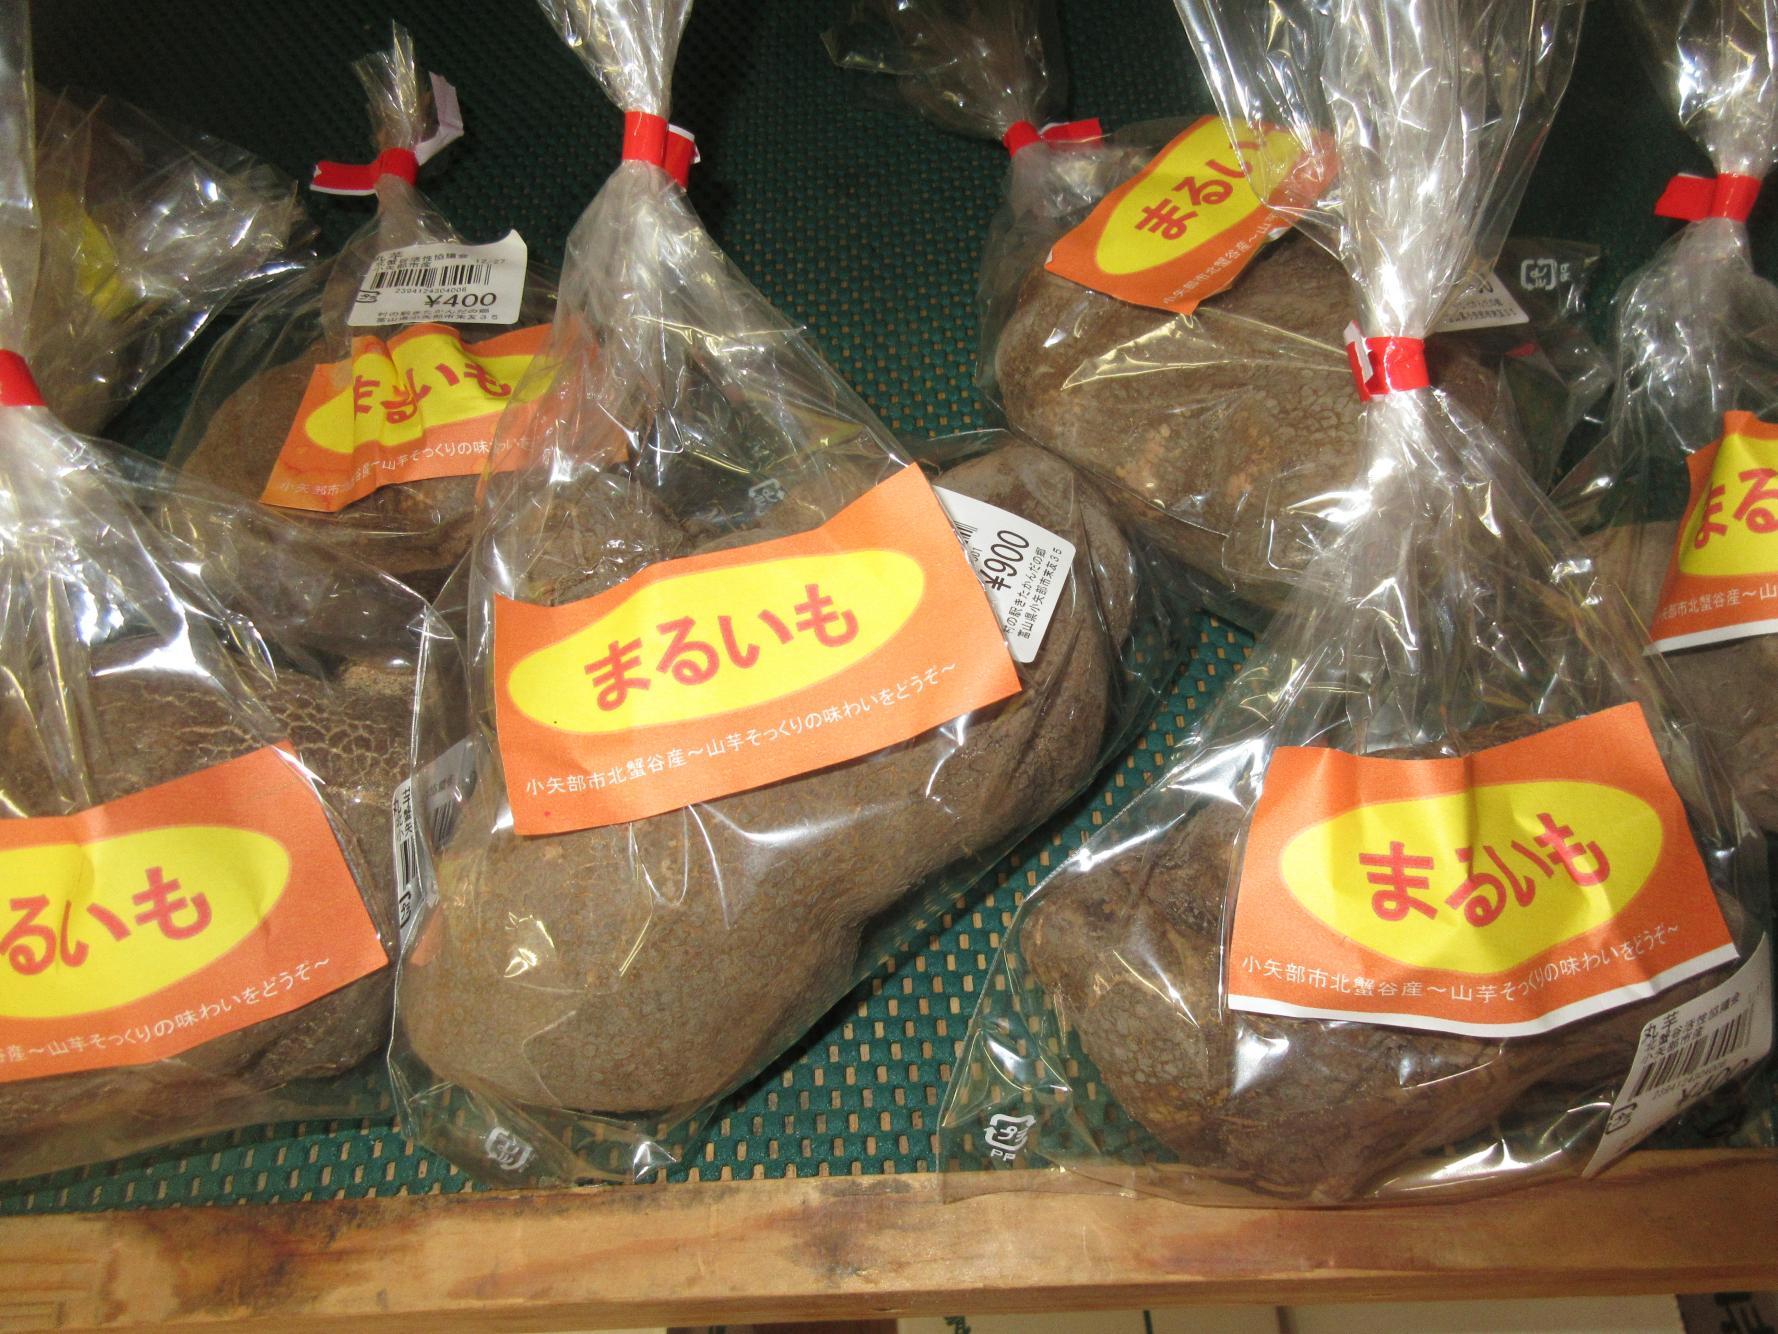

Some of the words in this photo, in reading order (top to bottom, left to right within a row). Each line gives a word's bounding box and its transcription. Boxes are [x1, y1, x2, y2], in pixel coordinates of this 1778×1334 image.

[424, 292, 498, 308] ¥400
[980, 530, 1029, 591] ¥900
[583, 583, 859, 712] まるいも
[1358, 812, 1611, 928] まるいも
[0, 957, 331, 1063] 産〜山芋そっくりの味わいをどうぞ〜
